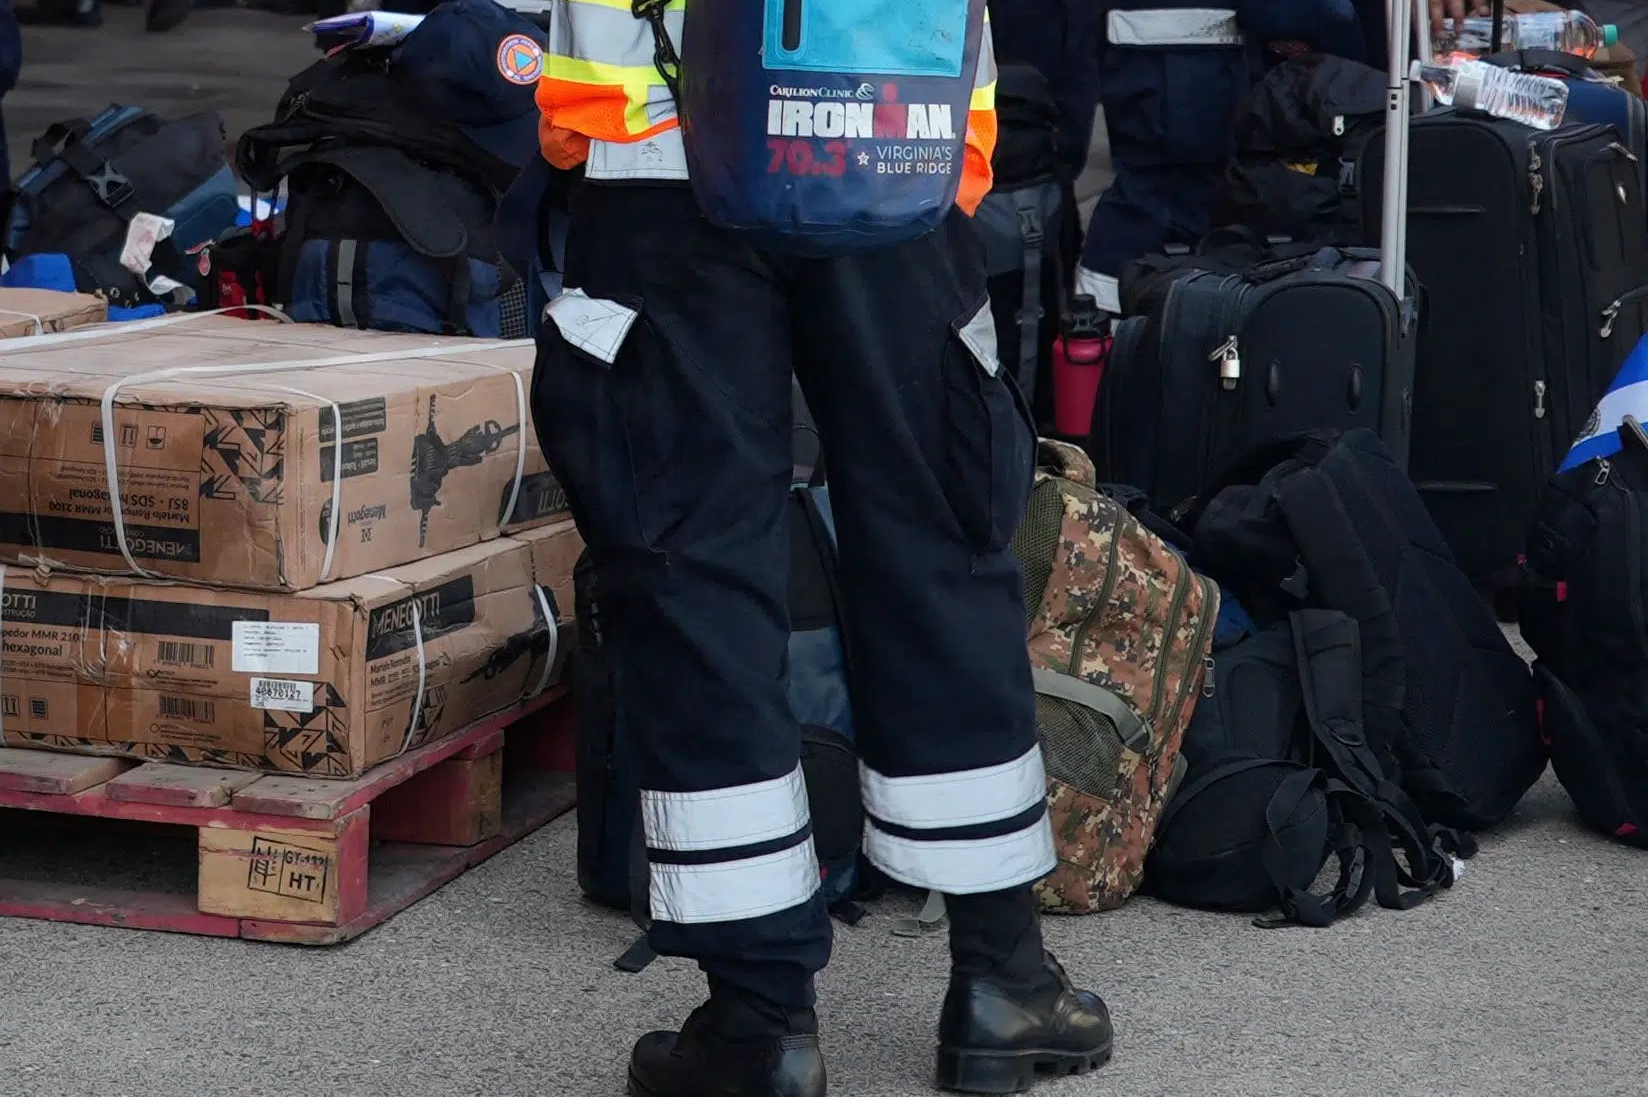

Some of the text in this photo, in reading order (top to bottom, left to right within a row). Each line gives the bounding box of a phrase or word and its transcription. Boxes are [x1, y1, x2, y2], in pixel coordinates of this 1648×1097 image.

[767, 83, 954, 139] IRONMAN
[766, 139, 848, 177] 70.3
[876, 145, 953, 161] VIRGINIA'S
[877, 162, 952, 175] BLUE RIDGE
[31, 629, 59, 640] MMR
[60, 632, 83, 642] 210
[2, 639, 63, 657] hexagonal
[289, 871, 317, 892] HT
